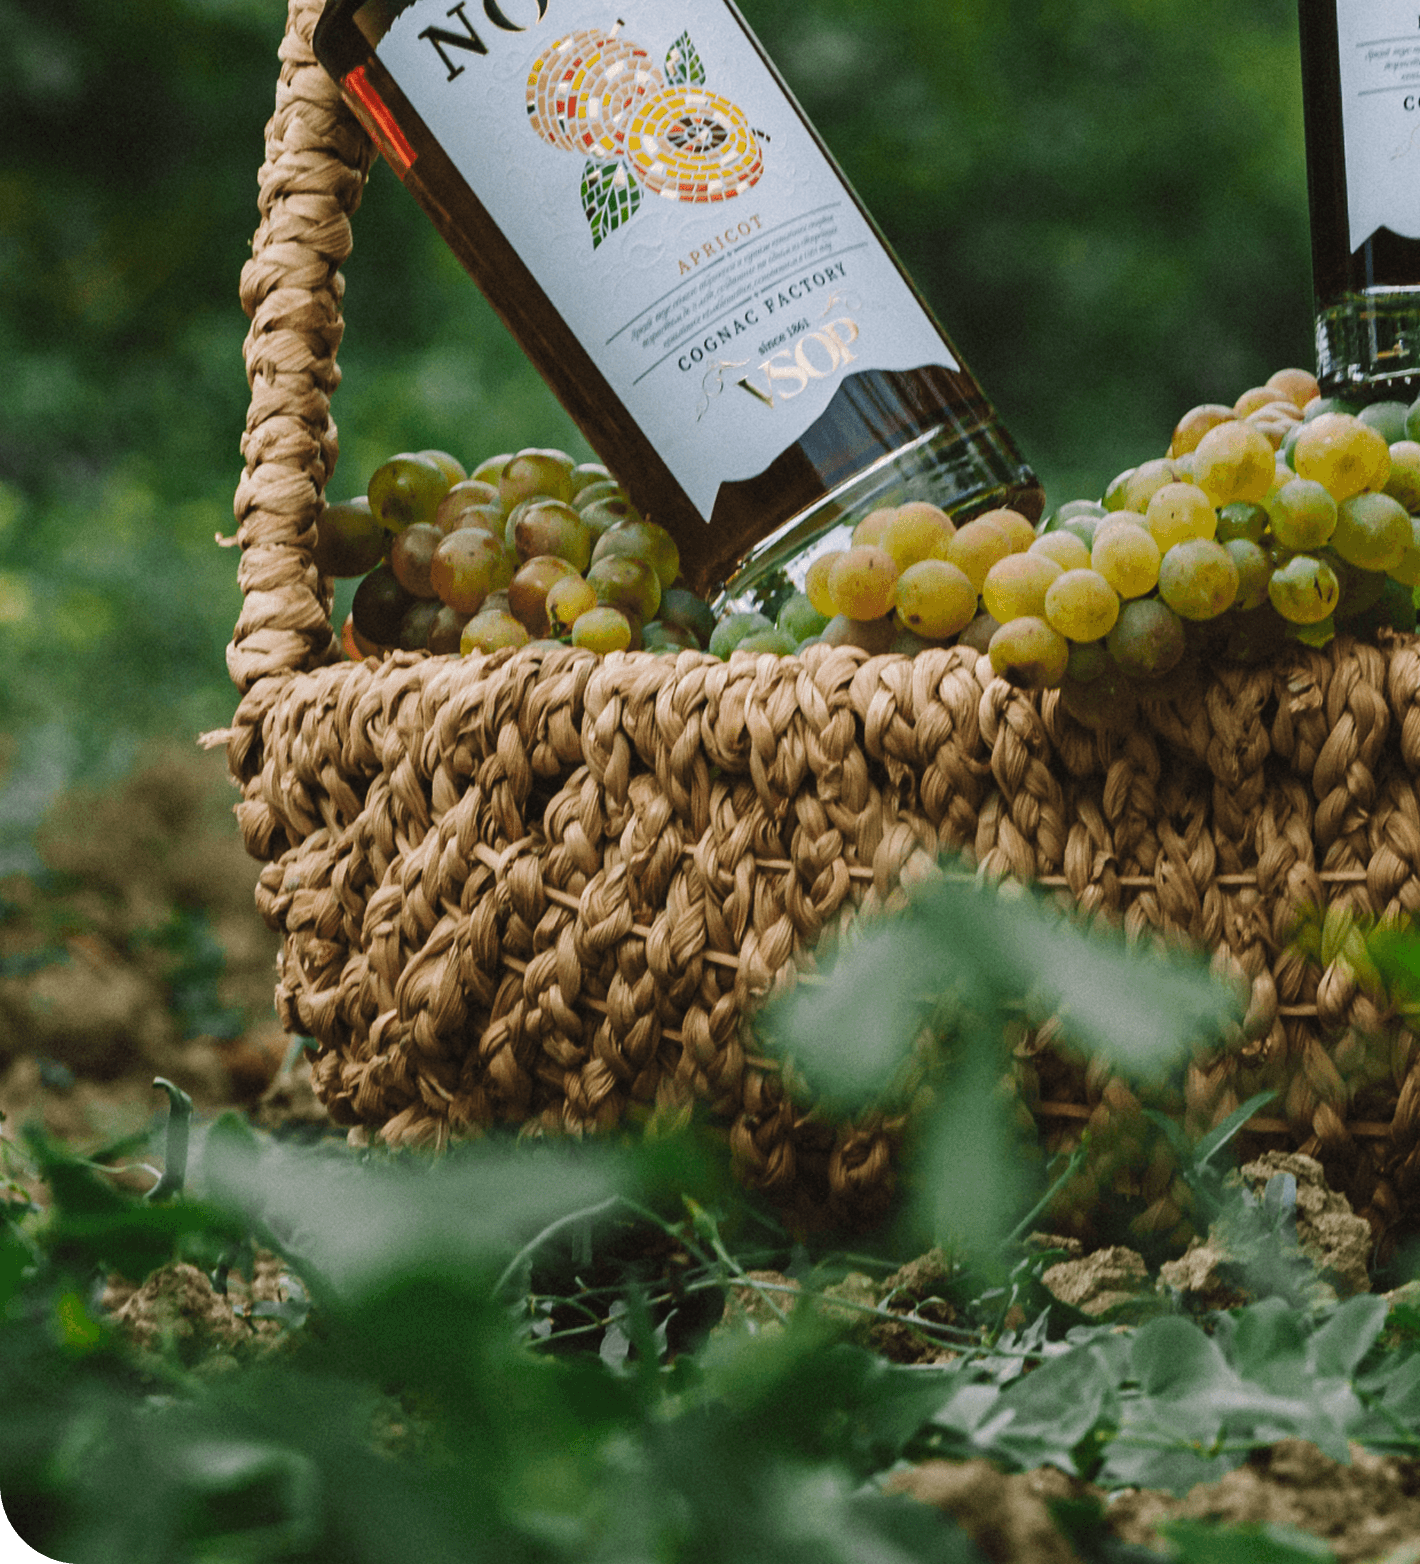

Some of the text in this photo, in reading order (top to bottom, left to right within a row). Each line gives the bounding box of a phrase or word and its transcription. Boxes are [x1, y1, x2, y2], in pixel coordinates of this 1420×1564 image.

[676, 213, 764, 275] APRICOT
[677, 310, 759, 372] COGNAC
[763, 261, 848, 315] FACTORY
[758, 316, 811, 355] since 1861
[737, 317, 859, 409] VSOP
